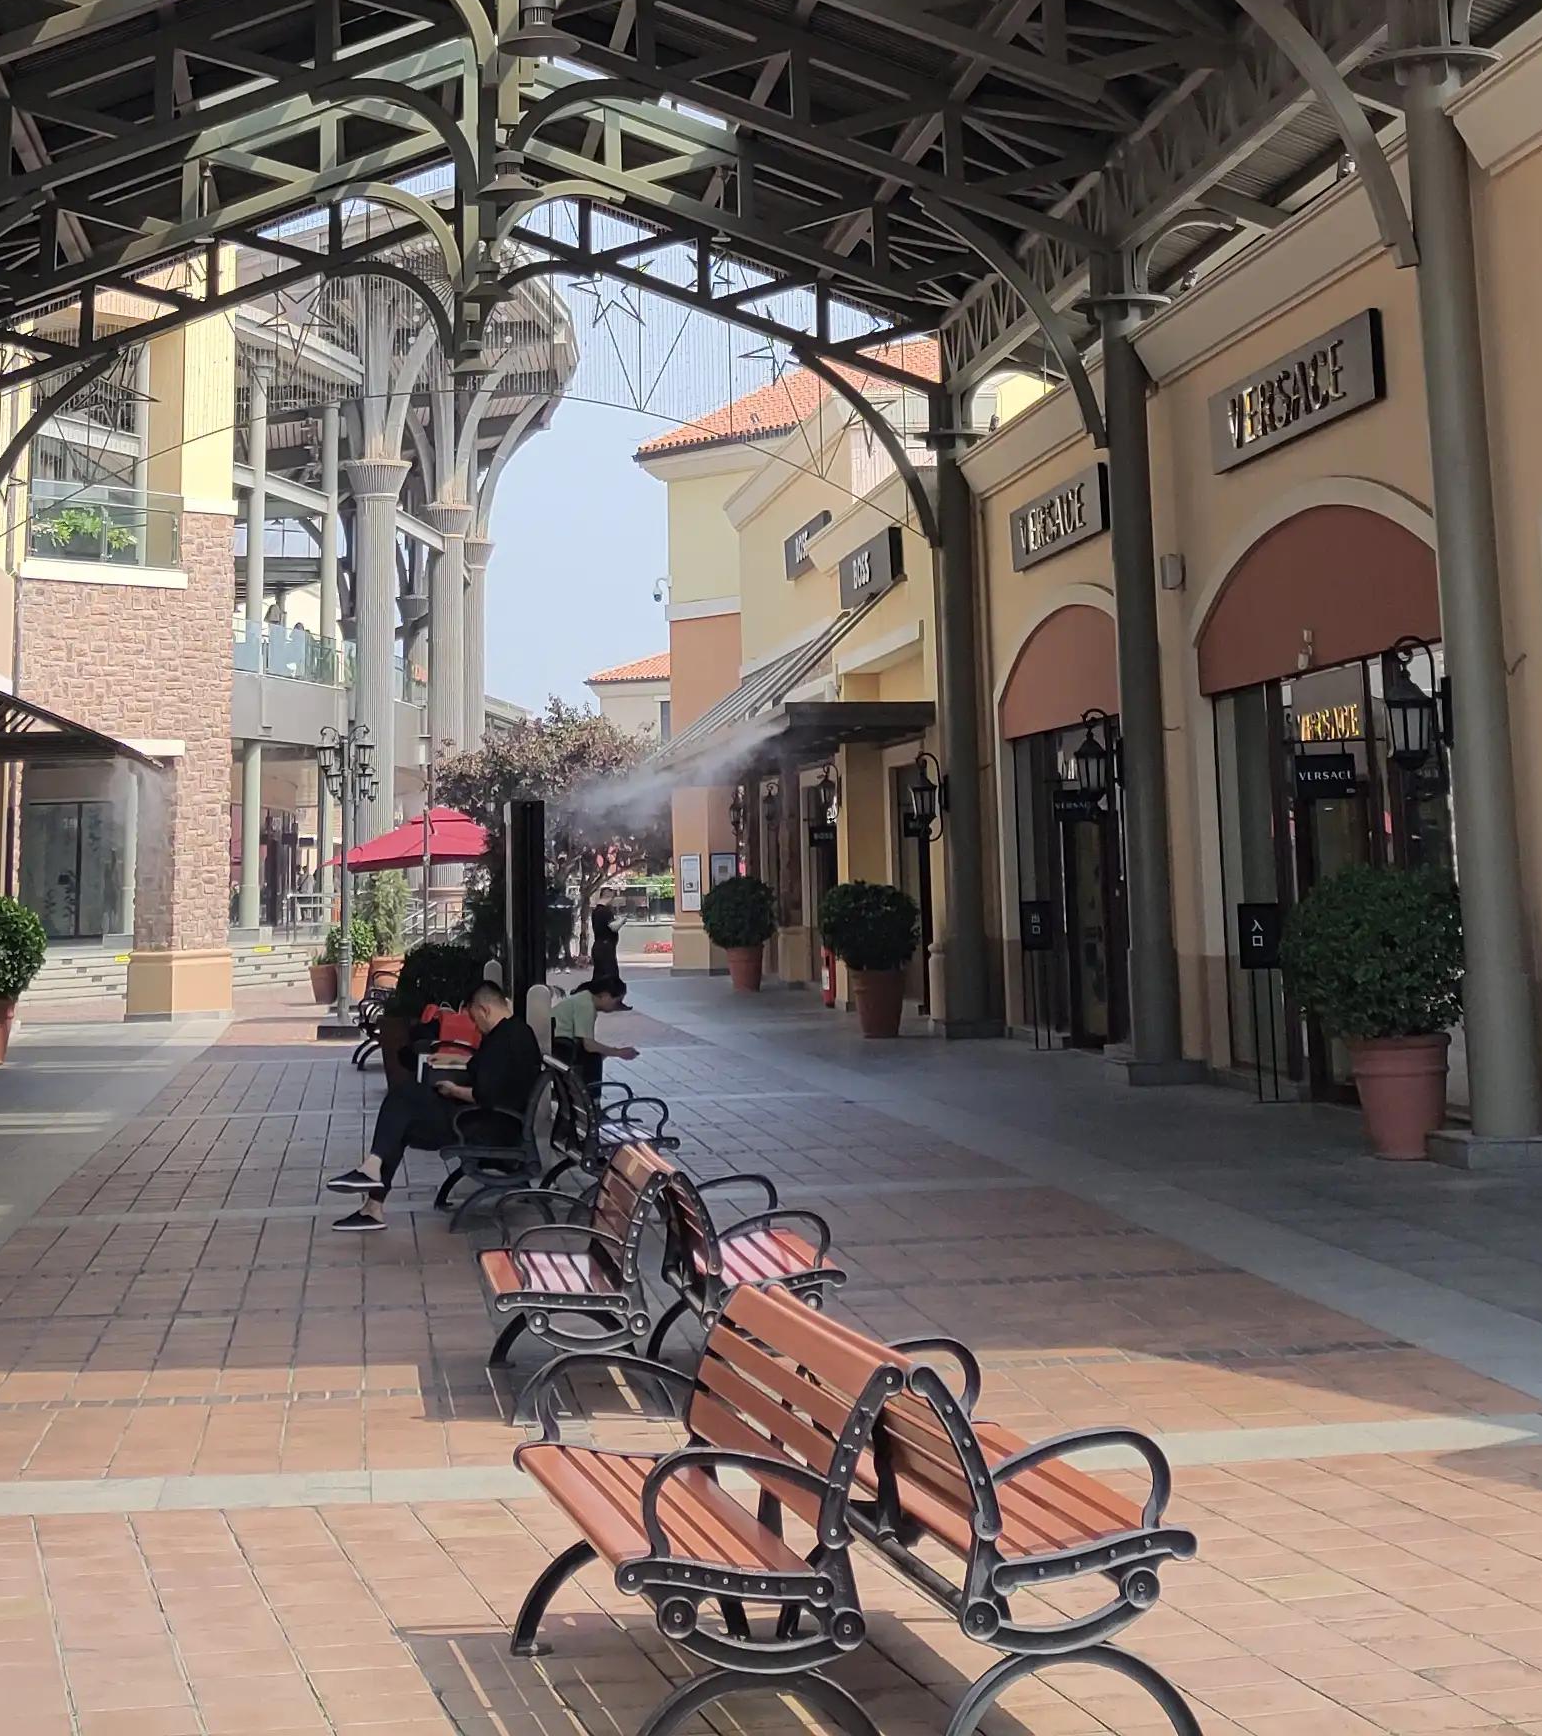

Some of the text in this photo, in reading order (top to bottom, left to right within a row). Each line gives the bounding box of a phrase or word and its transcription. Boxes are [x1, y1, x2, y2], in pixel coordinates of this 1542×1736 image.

[1227, 339, 1348, 449] VERSACE
[1018, 482, 1088, 554] VERSACE
[852, 551, 871, 590] BOSS
[1299, 769, 1354, 781] VERSACE
[1250, 919, 1264, 947] 入口
